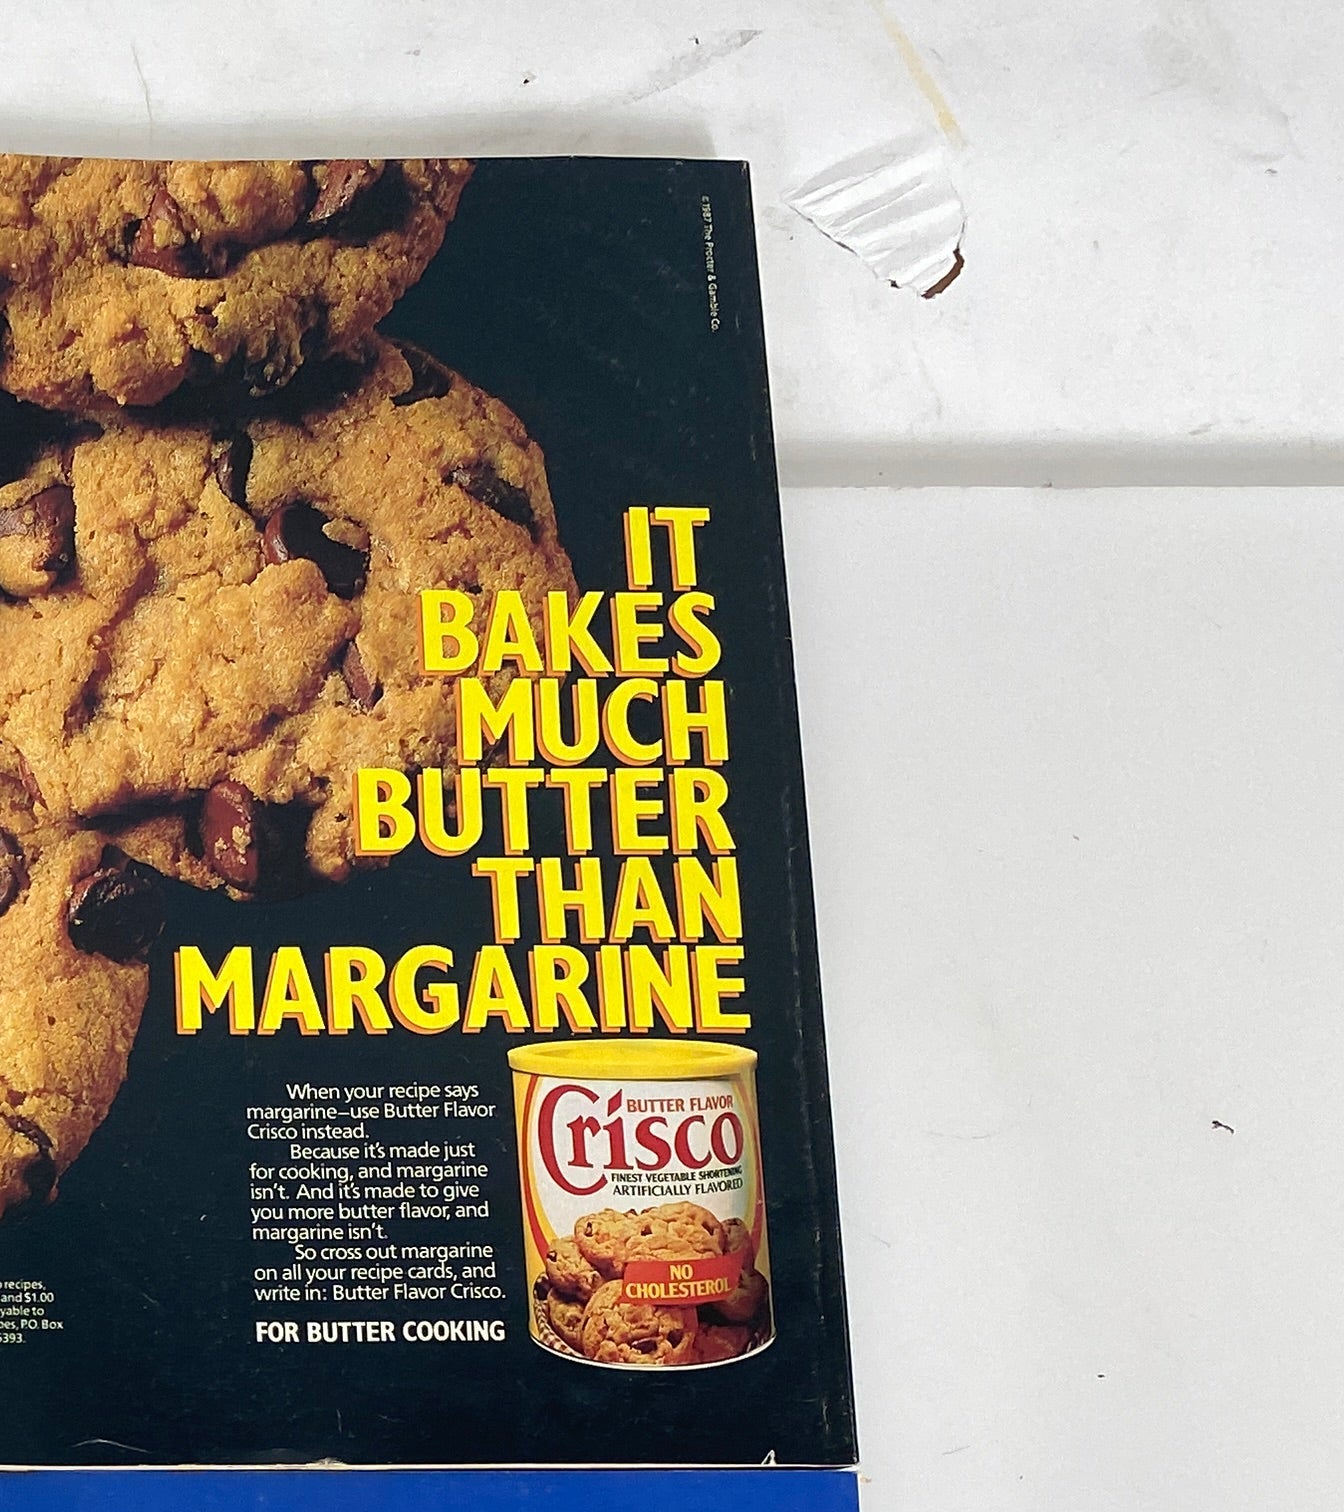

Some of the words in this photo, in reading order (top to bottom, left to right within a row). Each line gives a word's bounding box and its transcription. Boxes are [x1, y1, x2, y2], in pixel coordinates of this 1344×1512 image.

[623, 505, 712, 591] IT
[418, 589, 723, 678] BAKES
[455, 678, 730, 767] MUCH
[352, 767, 737, 857] BUTTER
[472, 857, 745, 945] THAN
[173, 944, 752, 1036] MARGARINE
[286, 1083, 340, 1100] When
[344, 1087, 385, 1103] your
[389, 1082, 441, 1102] recipe
[444, 1085, 479, 1101] says
[627, 1098, 685, 1113] BUTTER
[690, 1095, 733, 1112] FLAVOR
[538, 1084, 745, 1195] Crisco
[611, 1173, 643, 1183] FINEST
[645, 1172, 697, 1183] VEGETABLE
[698, 1166, 743, 1180] SHORTENING
[613, 1184, 692, 1197] ARTIFICIALLY
[696, 1179, 744, 1196] FLAVORED
[669, 1264, 694, 1281] NO
[4, 1281, 46, 1291] recipes,
[625, 1279, 732, 1299] CHOLESTEROL
[256, 1322, 299, 1342] FOR
[307, 1321, 396, 1342] BUTTER
[403, 1320, 505, 1341] COOKING
